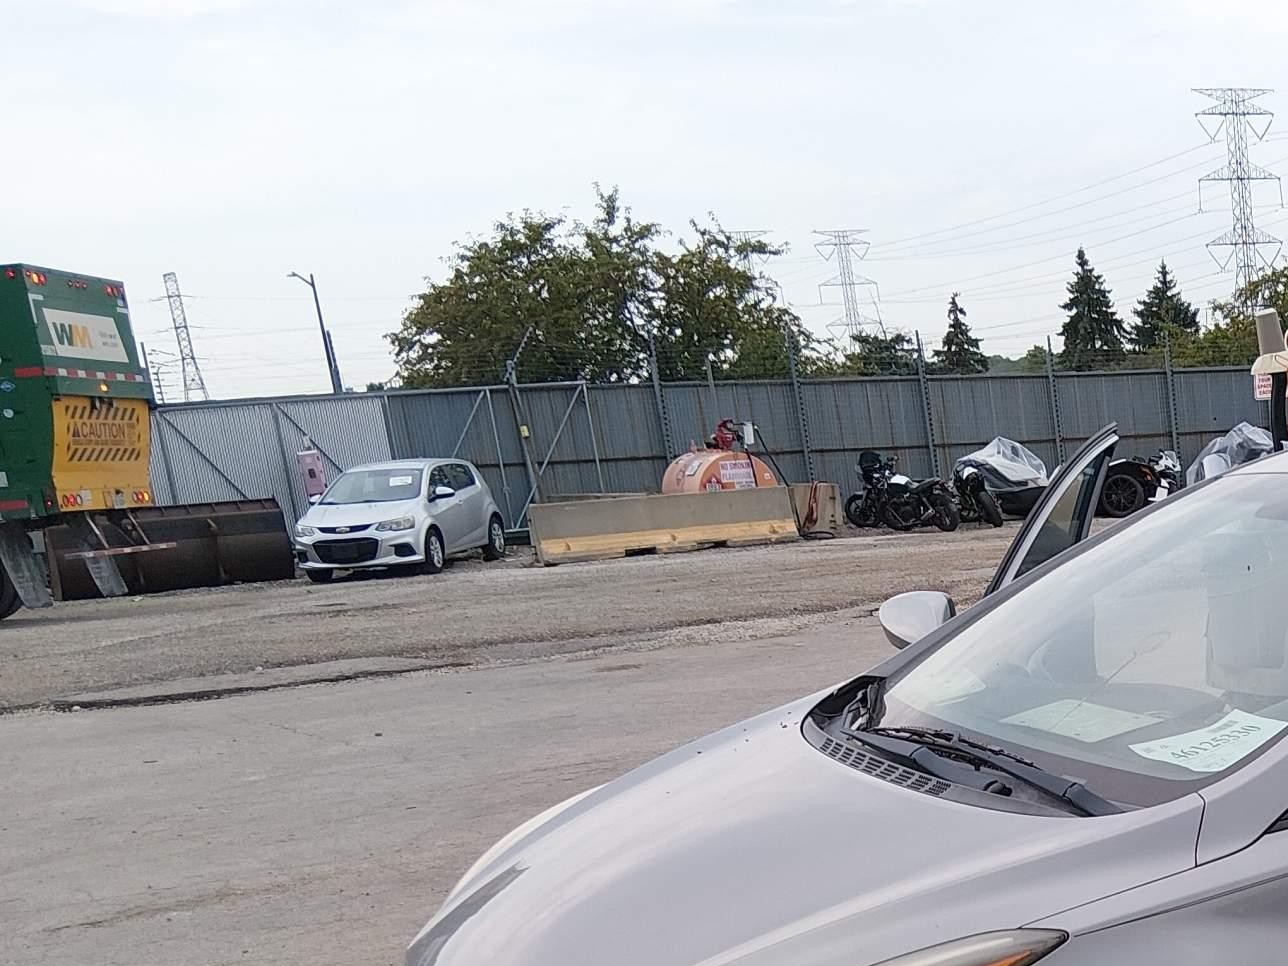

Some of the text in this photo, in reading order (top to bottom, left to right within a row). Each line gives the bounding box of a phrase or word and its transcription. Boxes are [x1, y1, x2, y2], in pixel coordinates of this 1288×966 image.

[52, 321, 93, 349] WM
[80, 422, 126, 439] CAUTION
[729, 461, 752, 470] SMOKIN
[1169, 724, 1262, 760] 46125330
